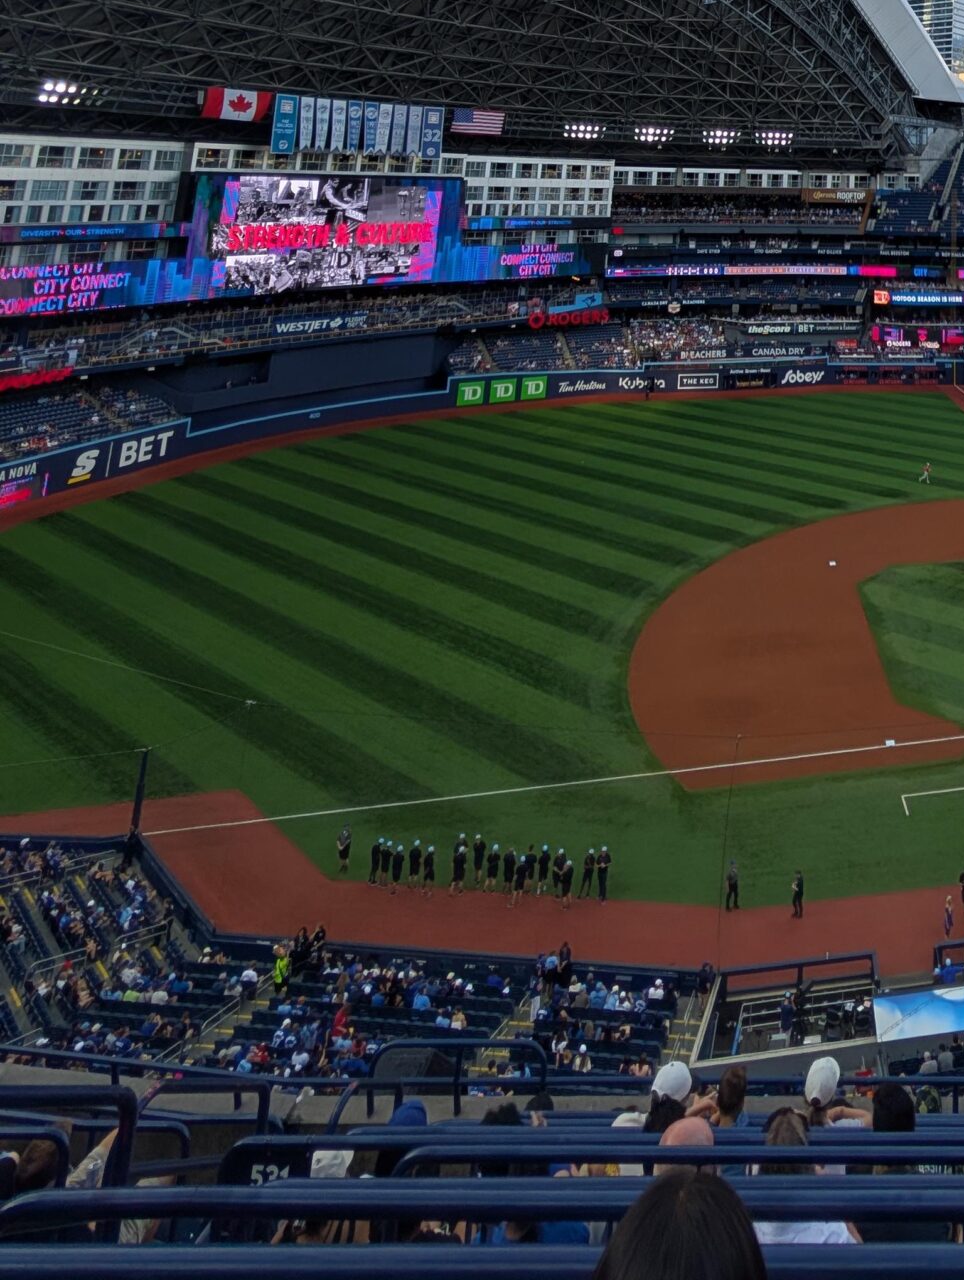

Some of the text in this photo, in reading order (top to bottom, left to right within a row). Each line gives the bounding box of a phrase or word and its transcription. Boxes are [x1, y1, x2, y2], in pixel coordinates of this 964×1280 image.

[424, 129, 440, 142] 32
[837, 192, 865, 200] ROOFTOP
[21, 230, 60, 238] DIVERSITY
[86, 228, 124, 236] STRENGTH
[227, 224, 330, 250] STRENGTH
[356, 223, 433, 245] CULTURE
[500, 252, 574, 266] CONNECT CONNECT
[519, 264, 557, 276] CITY CITY
[34, 273, 131, 296] CITY CONNECT
[67, 290, 100, 308] CITY
[546, 308, 609, 326] ROGERS
[276, 319, 330, 333] WESTJET
[748, 324, 791, 334] theScore
[798, 324, 814, 332] BET
[752, 348, 805, 356] CANADA DRY
[618, 377, 666, 389] Kuba
[781, 370, 825, 384] Sobeys
[461, 386, 482, 400] TD
[494, 383, 513, 398] TD
[524, 380, 544, 394] TD
[558, 380, 606, 392] Tim Hortons
[119, 431, 174, 468] BET
[9, 462, 37, 480] NOVA
